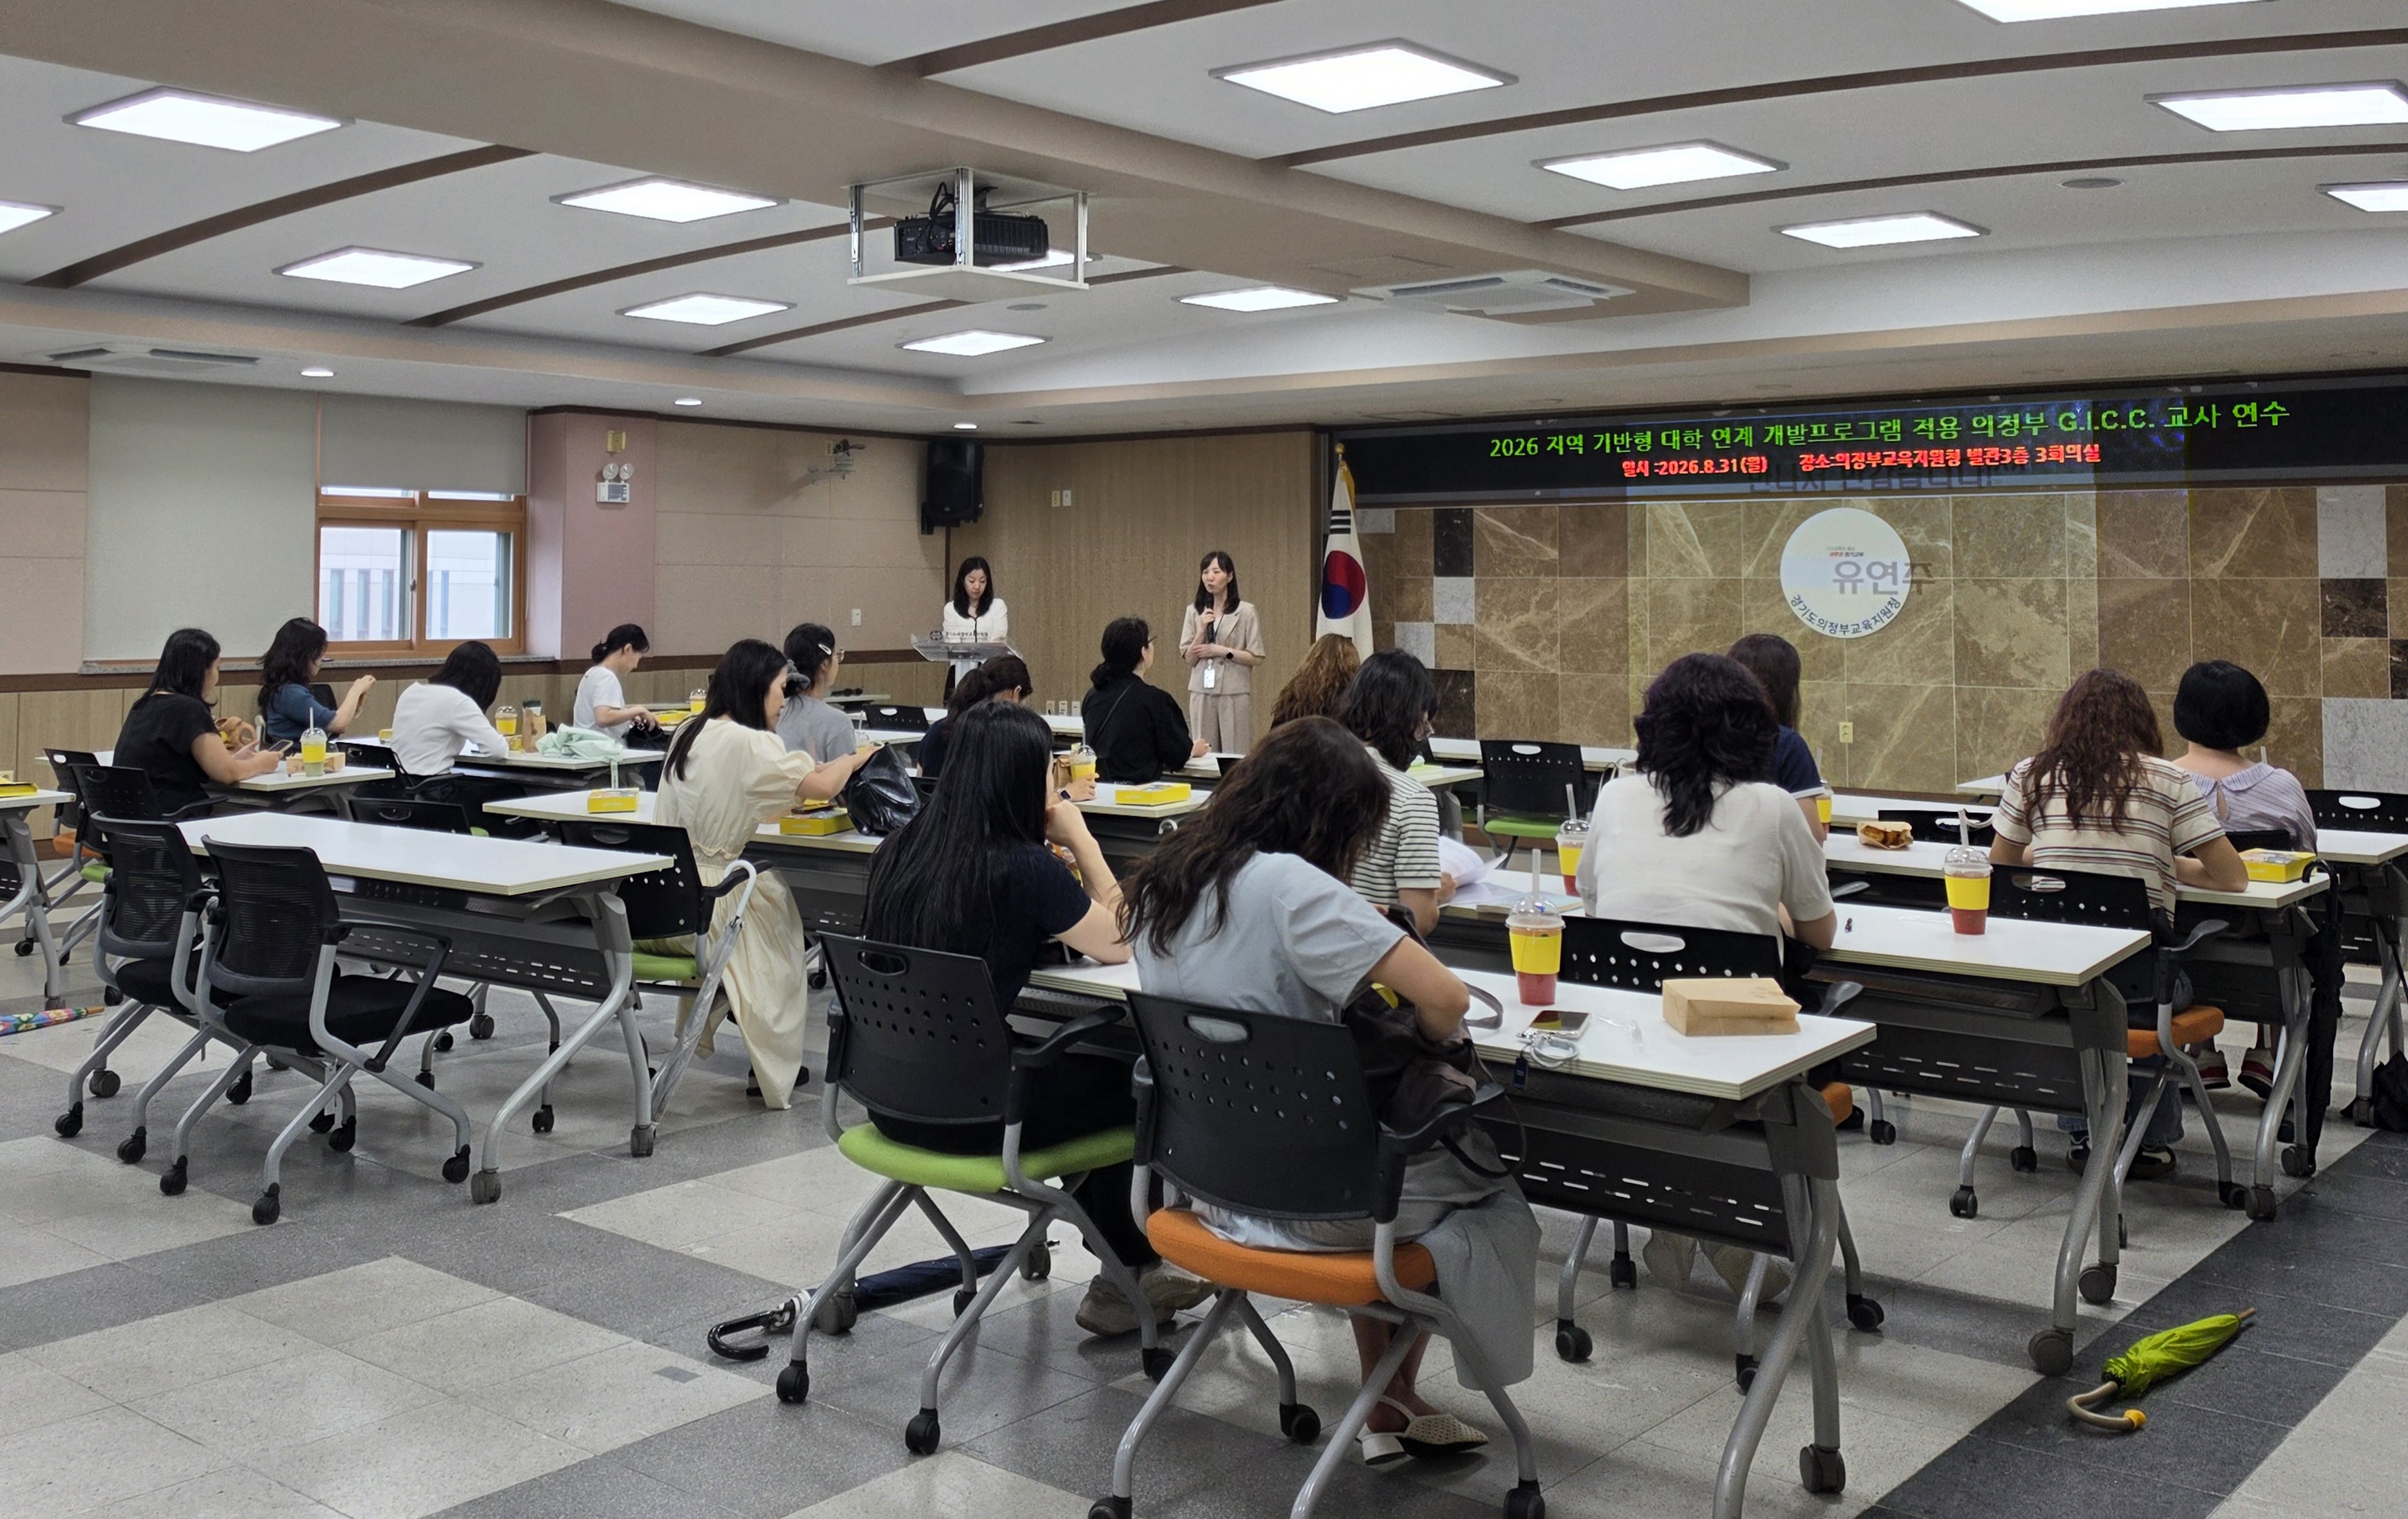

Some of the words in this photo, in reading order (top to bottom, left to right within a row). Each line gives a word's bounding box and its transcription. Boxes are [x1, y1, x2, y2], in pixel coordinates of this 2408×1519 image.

[1490, 438, 1538, 457] 2026
[1547, 434, 1583, 455] 지역
[1593, 431, 1651, 453] 기반형
[1661, 428, 1703, 450] 대학
[1712, 426, 1753, 448] 연계
[1763, 419, 1901, 446] 개발프로그램
[1913, 416, 1962, 440] 적용
[1972, 413, 2048, 438] 의정부
[2058, 409, 2155, 432] G.I.C.C.
[2164, 404, 2221, 428] 교사
[2232, 401, 2290, 427] 연수
[1622, 460, 1649, 477] 일시
[1967, 446, 2030, 466] 별관3층
[2035, 443, 2101, 463] 3회의실
[1832, 560, 1935, 596] 유연주
[1790, 593, 1901, 636] 경기도의정부교육지원청
